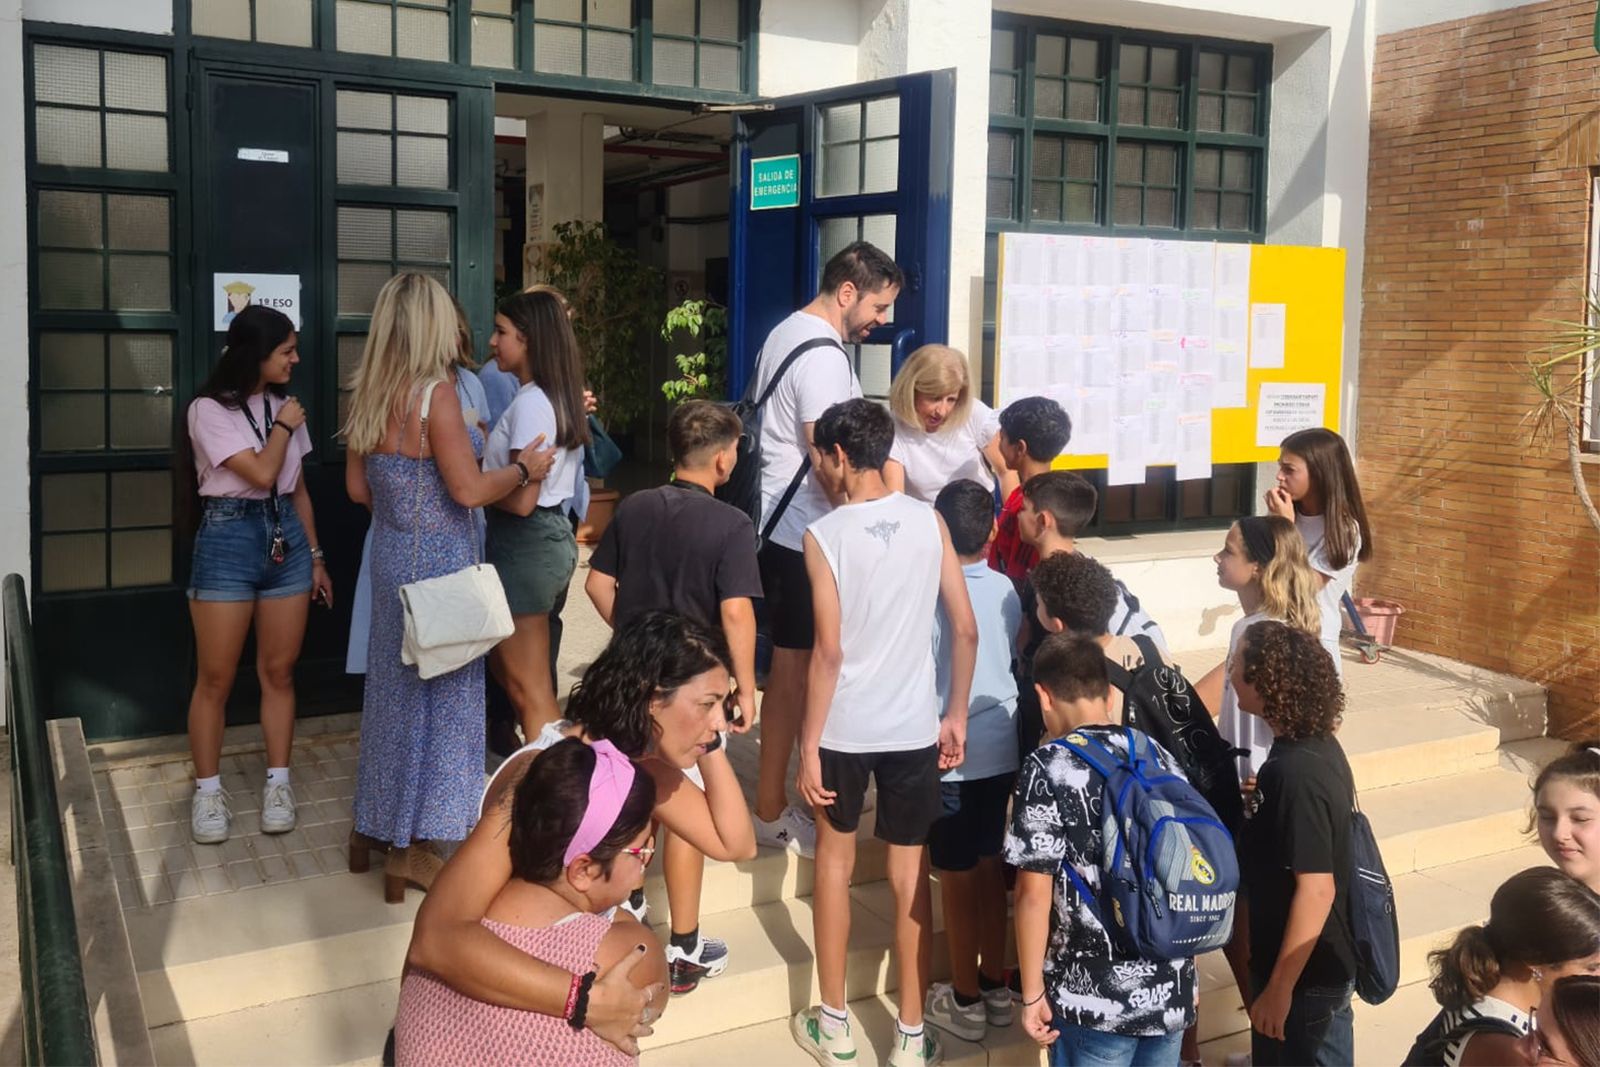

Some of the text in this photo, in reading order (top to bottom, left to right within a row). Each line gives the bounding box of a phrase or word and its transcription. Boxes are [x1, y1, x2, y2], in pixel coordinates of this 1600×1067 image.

[759, 169, 794, 182] SALIDA DE
[754, 183, 797, 196] EMERGENCIA
[272, 298, 293, 308] ESO
[1168, 893, 1199, 912] REAL
